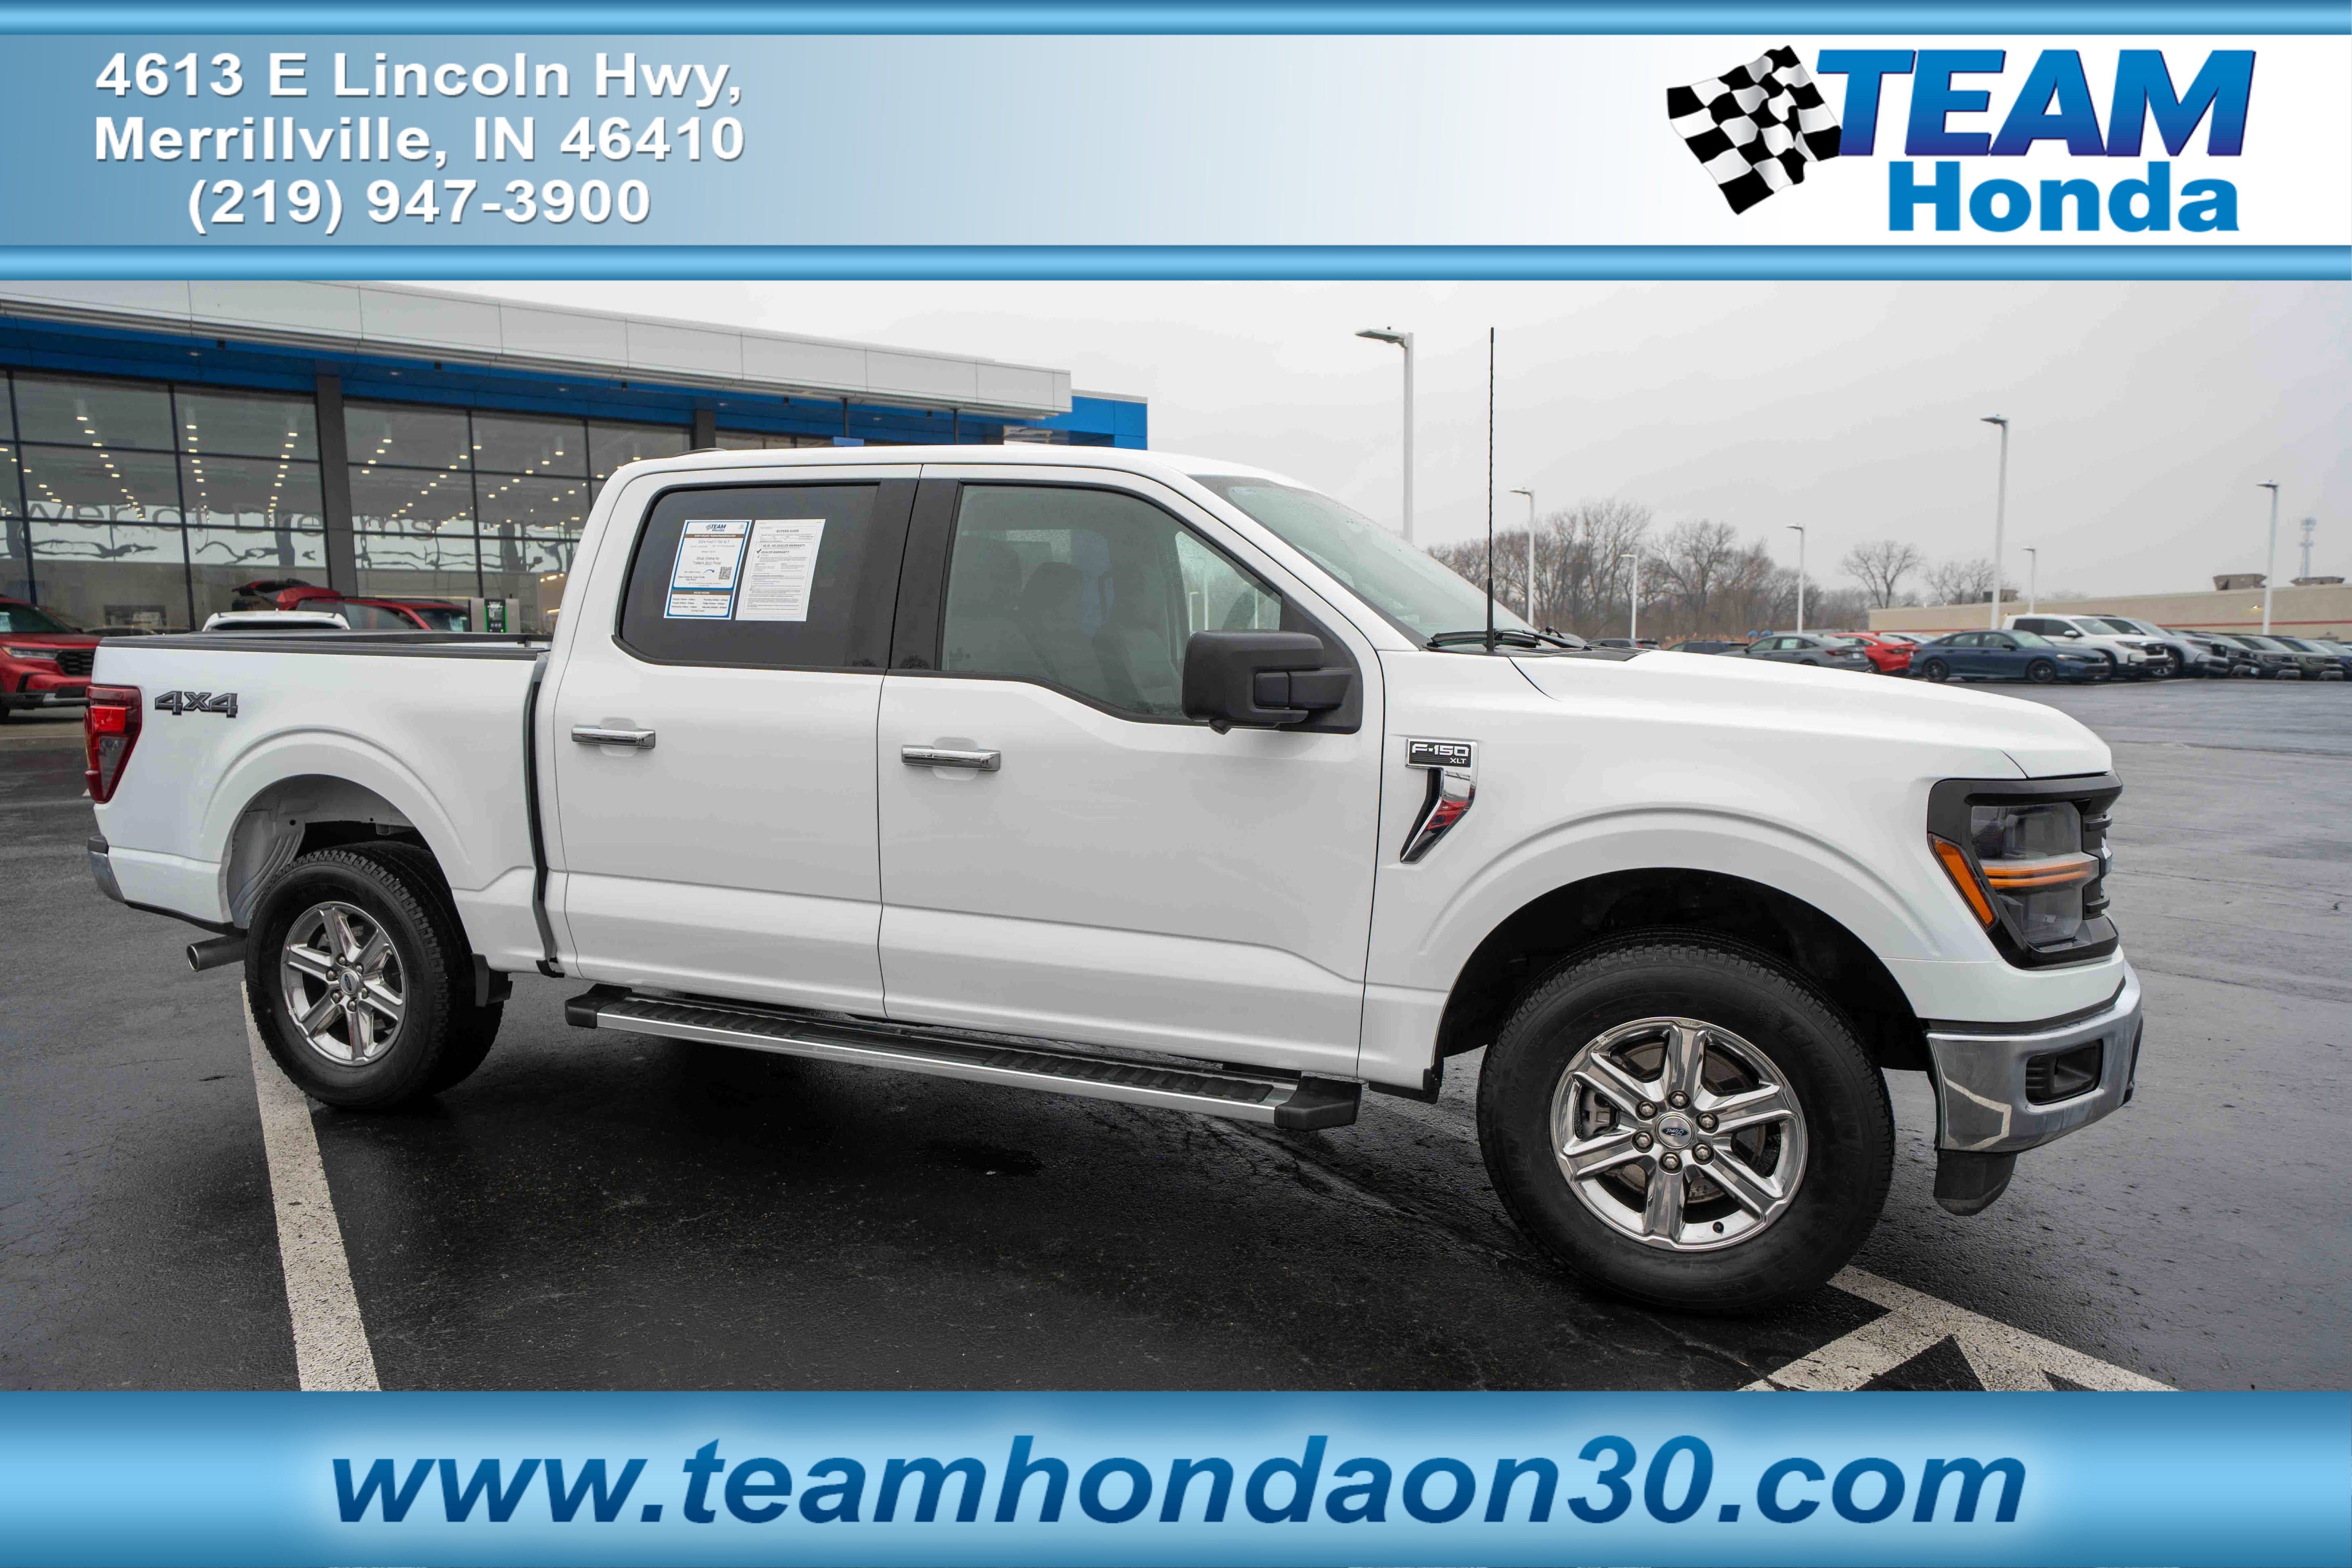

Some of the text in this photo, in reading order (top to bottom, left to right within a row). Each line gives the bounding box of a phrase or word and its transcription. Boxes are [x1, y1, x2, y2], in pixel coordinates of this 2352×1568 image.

[234, 503, 436, 541] Drems
[1412, 743, 1469, 757] F-150
[1666, 1128, 1684, 1136] Ford
